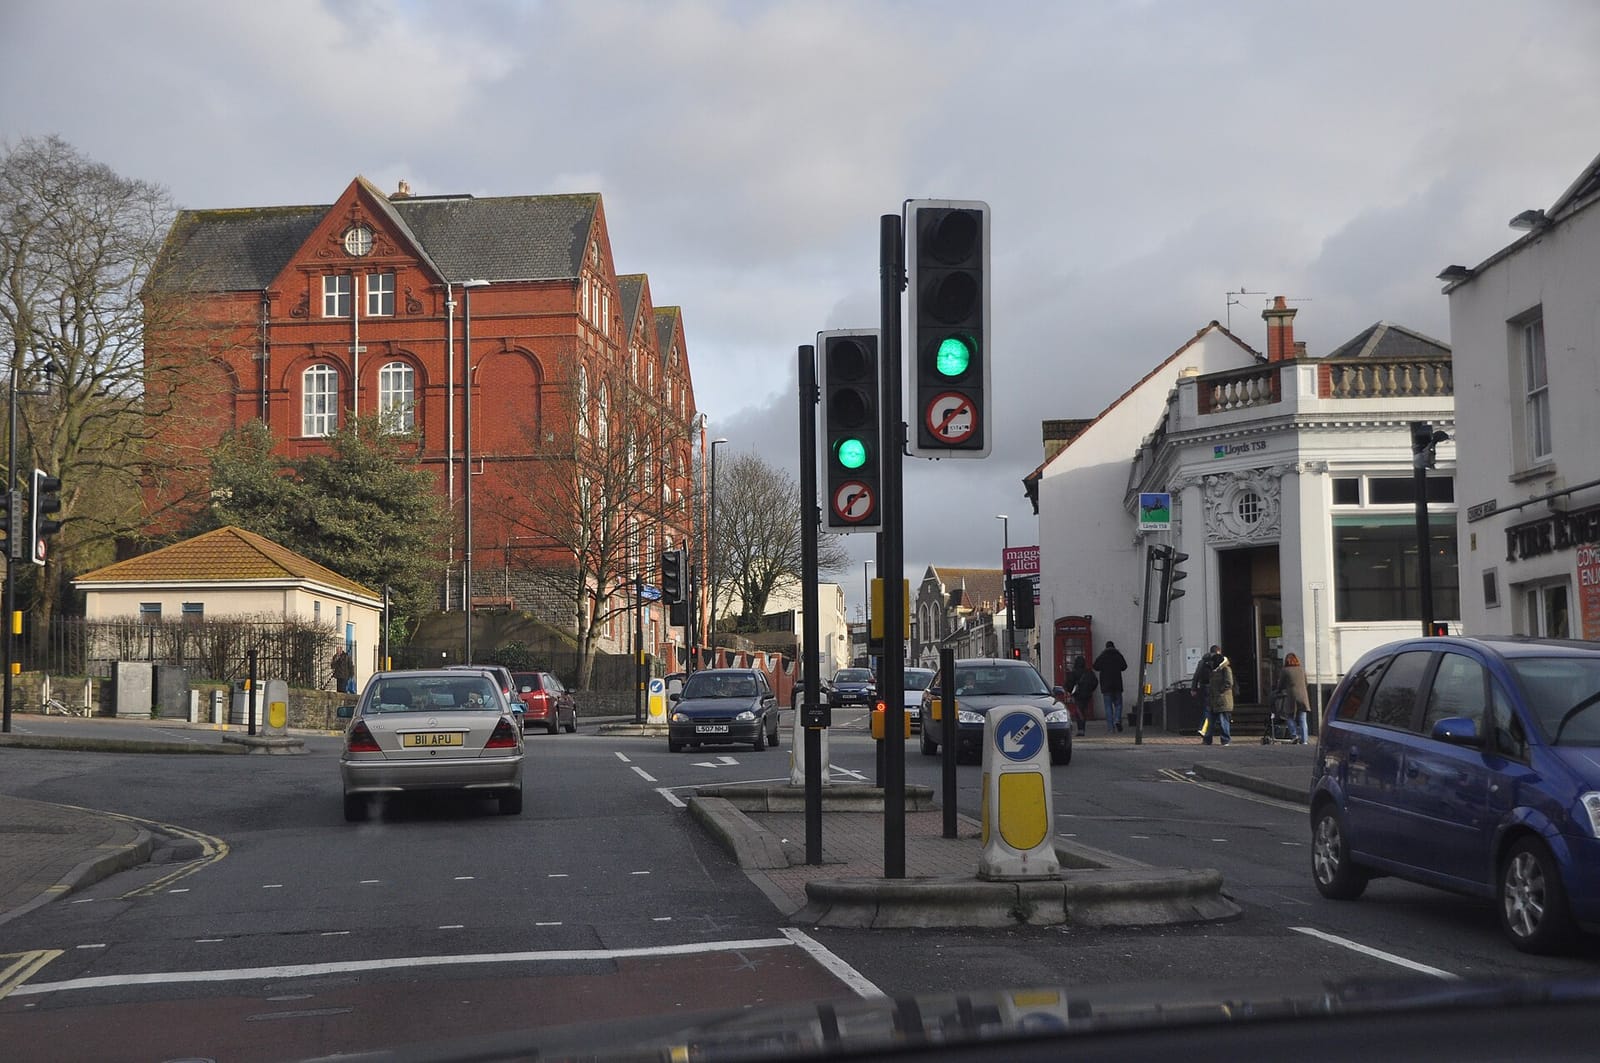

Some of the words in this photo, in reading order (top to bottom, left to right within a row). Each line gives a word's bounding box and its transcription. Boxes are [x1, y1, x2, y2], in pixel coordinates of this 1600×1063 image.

[1225, 442, 1250, 455] Lloyds
[1251, 440, 1266, 451] TSB
[1010, 559, 1038, 571] allen
[431, 734, 452, 745] APU
